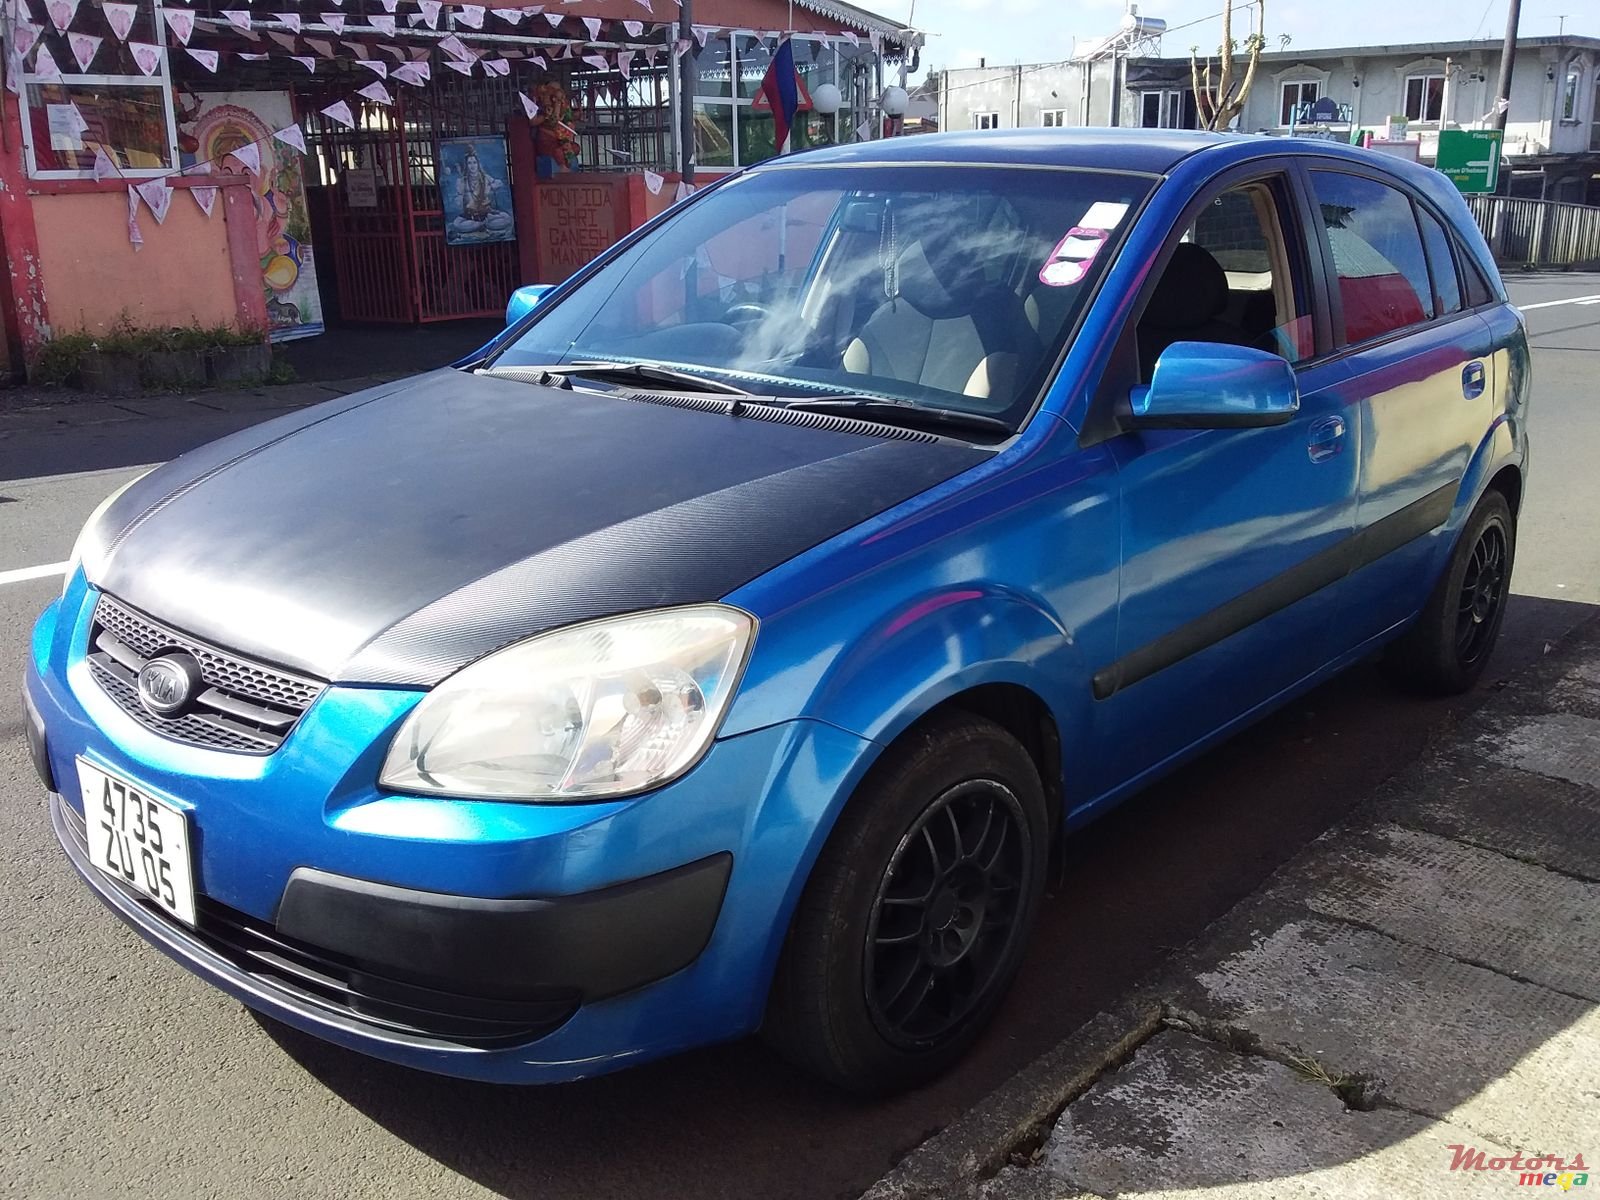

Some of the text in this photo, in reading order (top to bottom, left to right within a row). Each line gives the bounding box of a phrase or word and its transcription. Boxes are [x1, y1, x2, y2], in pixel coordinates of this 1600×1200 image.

[558, 208, 598, 227] SHRI
[103, 777, 163, 854] 4735
[101, 820, 176, 909] ZU 05
